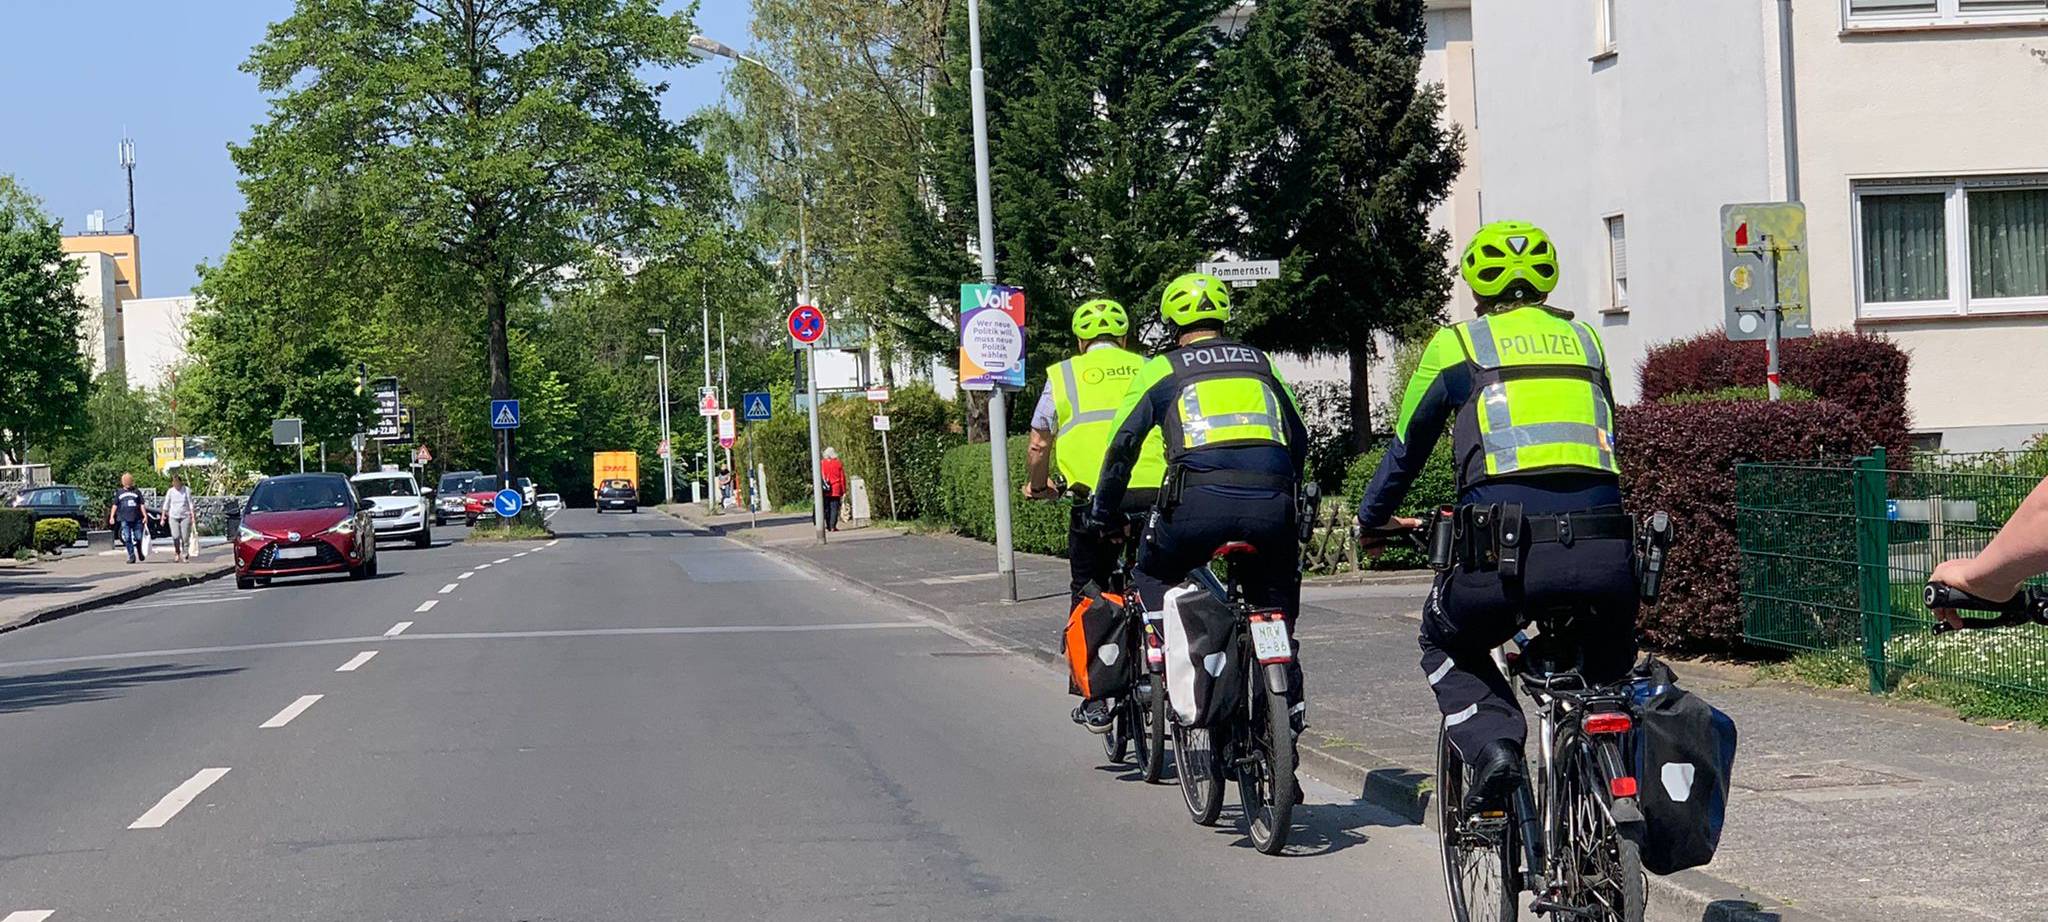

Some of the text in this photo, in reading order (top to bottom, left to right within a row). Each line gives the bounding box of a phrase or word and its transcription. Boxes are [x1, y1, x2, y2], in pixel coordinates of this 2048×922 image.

[1212, 266, 1271, 276] Pommernstr.
[975, 288, 1013, 310] Volt
[973, 327, 998, 335] Politik
[1499, 334, 1581, 356] POLIZEI
[1182, 346, 1259, 367] POLIZEI
[1259, 626, 1280, 640] NRW
